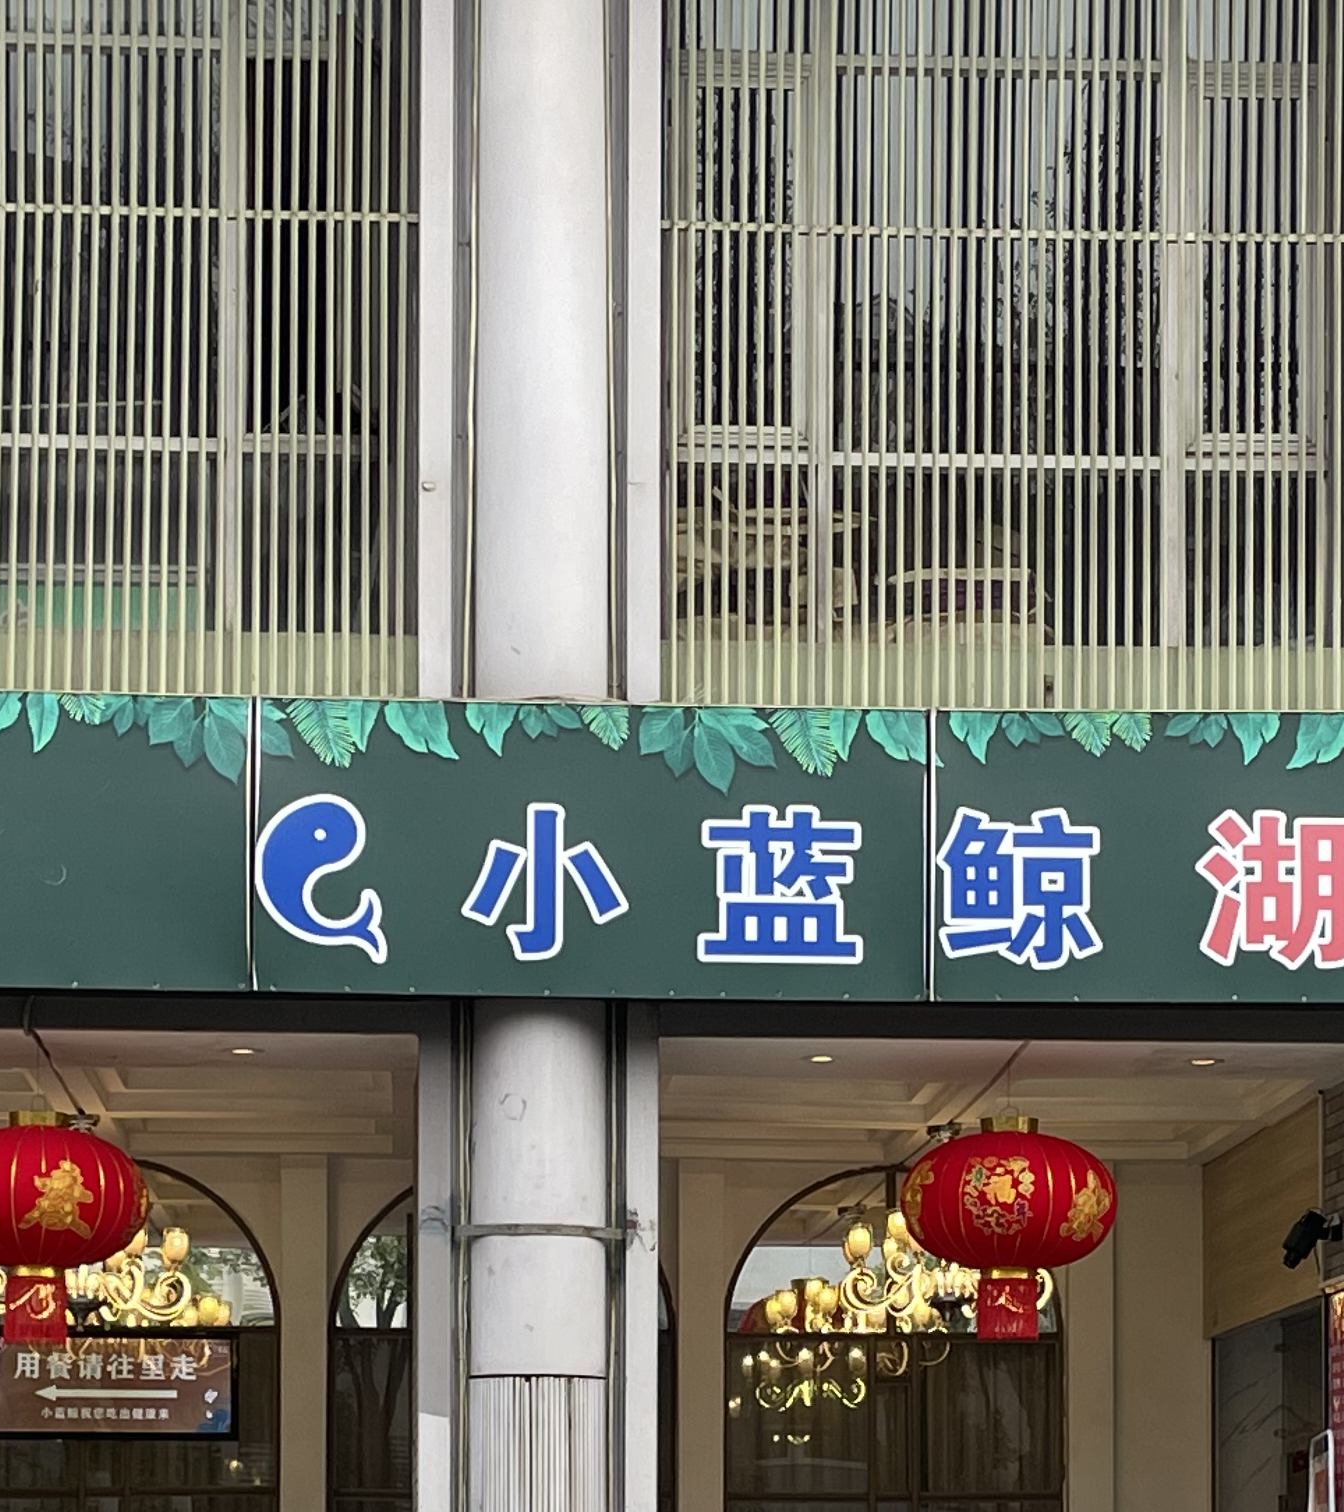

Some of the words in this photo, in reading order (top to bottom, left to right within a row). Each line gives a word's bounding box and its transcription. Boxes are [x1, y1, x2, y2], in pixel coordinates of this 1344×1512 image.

[14, 1352, 197, 1380] 用餐请往里走
